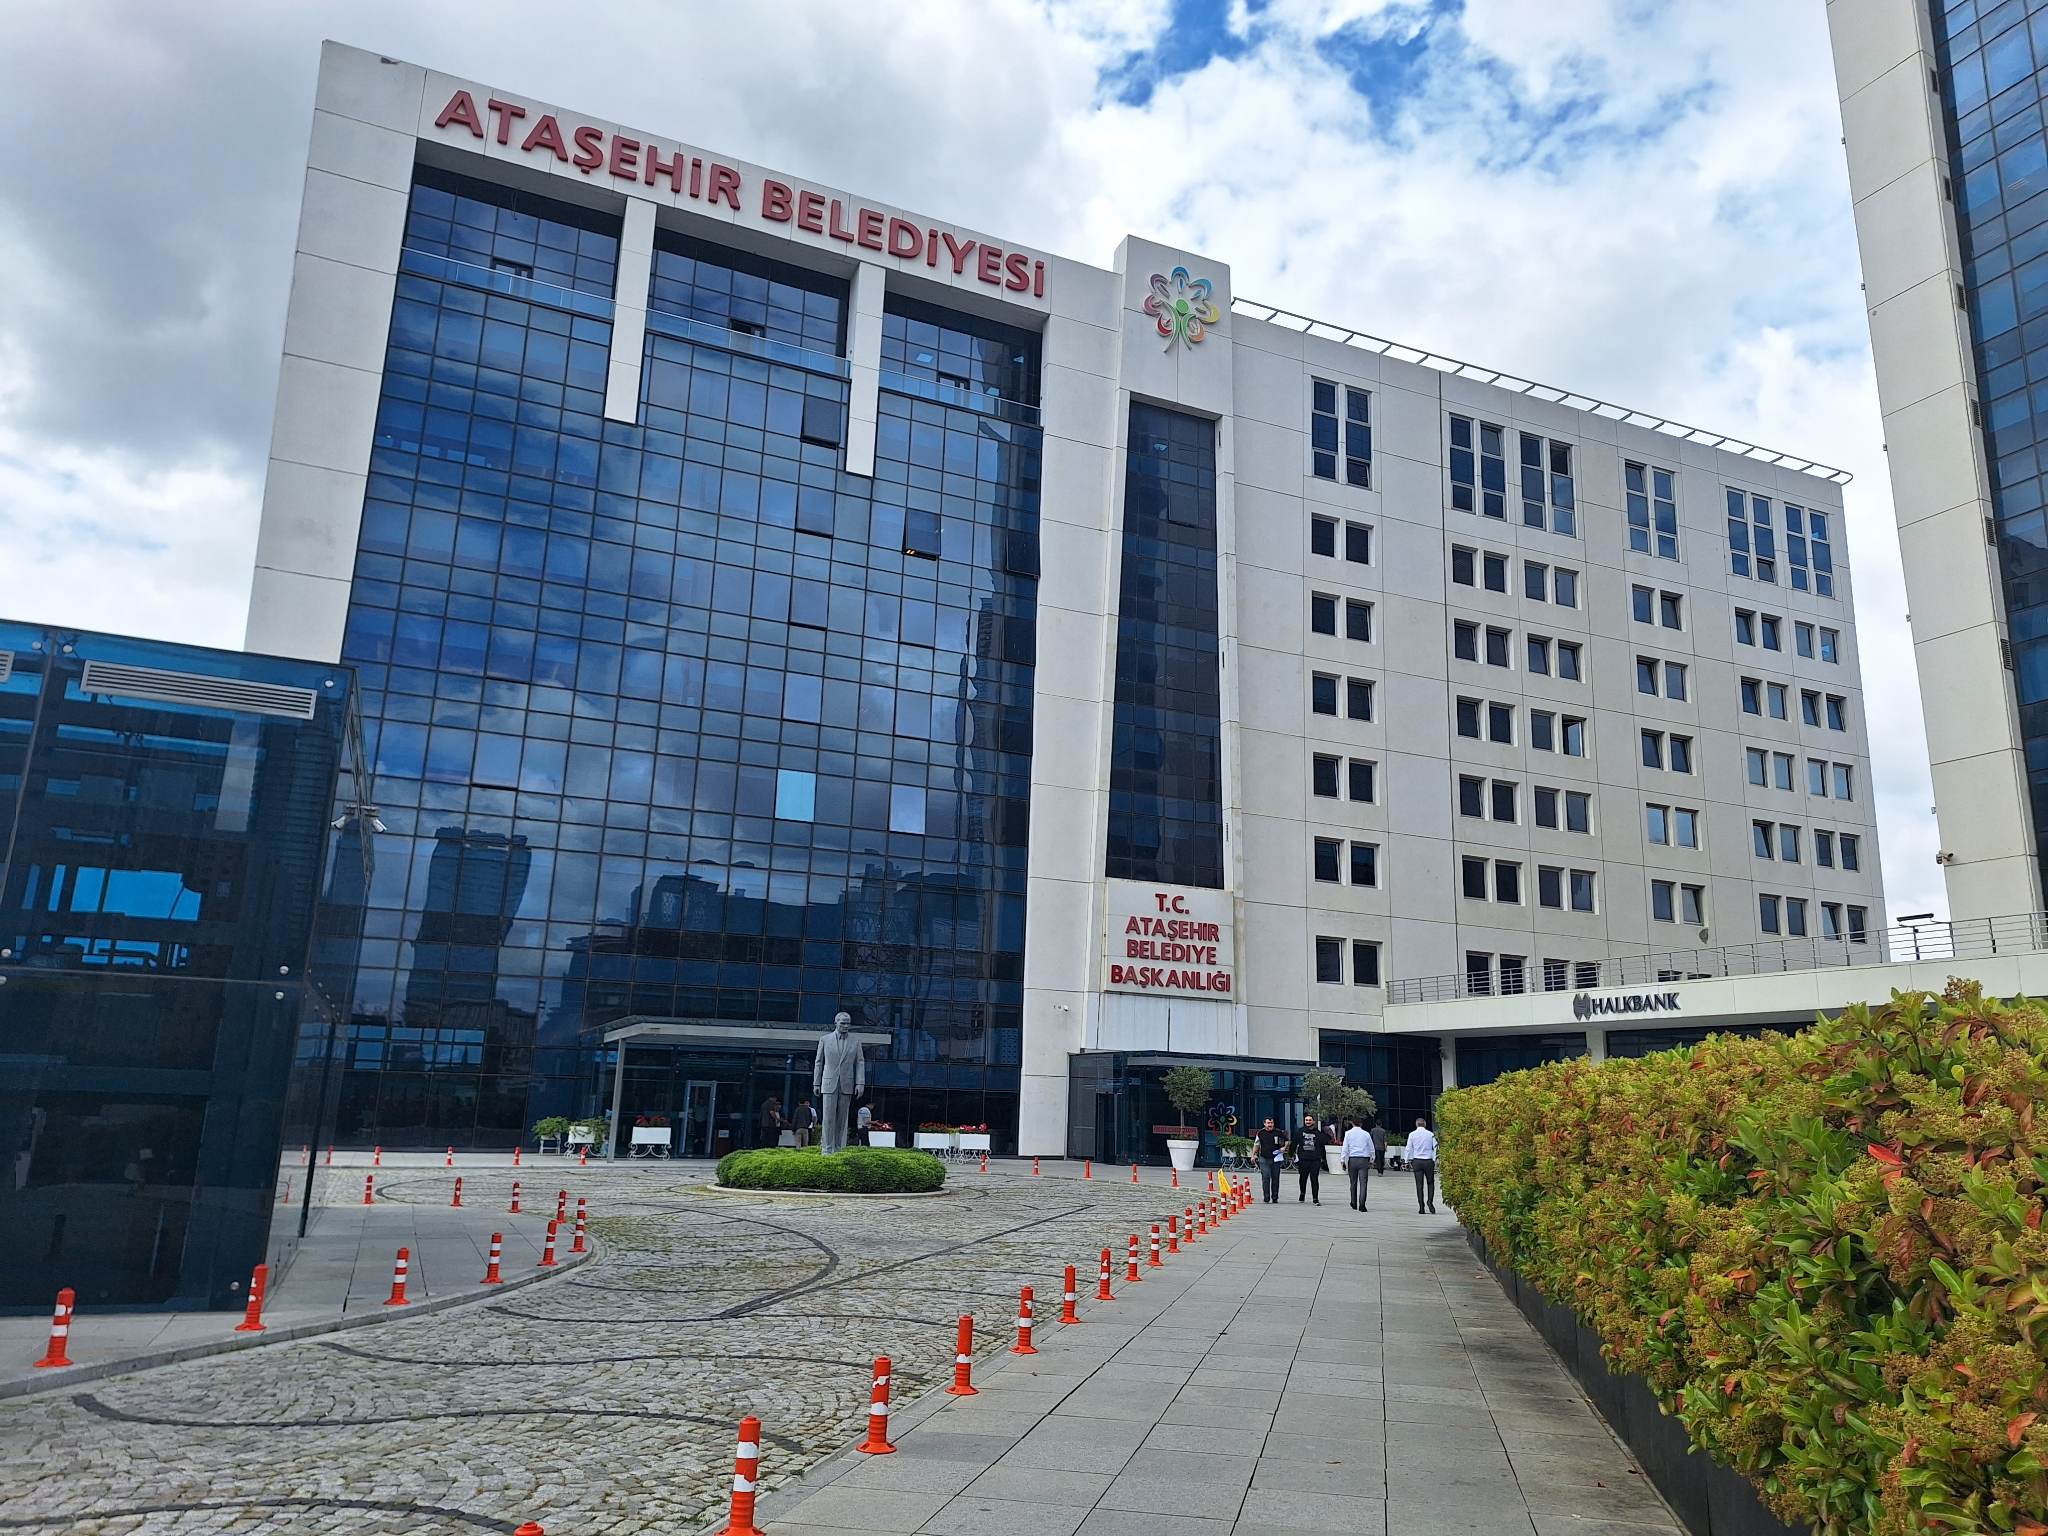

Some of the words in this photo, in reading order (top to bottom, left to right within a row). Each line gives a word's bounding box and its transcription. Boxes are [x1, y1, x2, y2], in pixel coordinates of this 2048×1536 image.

[434, 89, 741, 211] ATAŞEHİR
[761, 179, 1045, 297] BELEDİYESİ
[1155, 893, 1190, 914] T.C.
[1111, 965, 1231, 992] BAŞKANLIĞI
[1592, 992, 1681, 1015] HALKBANK
